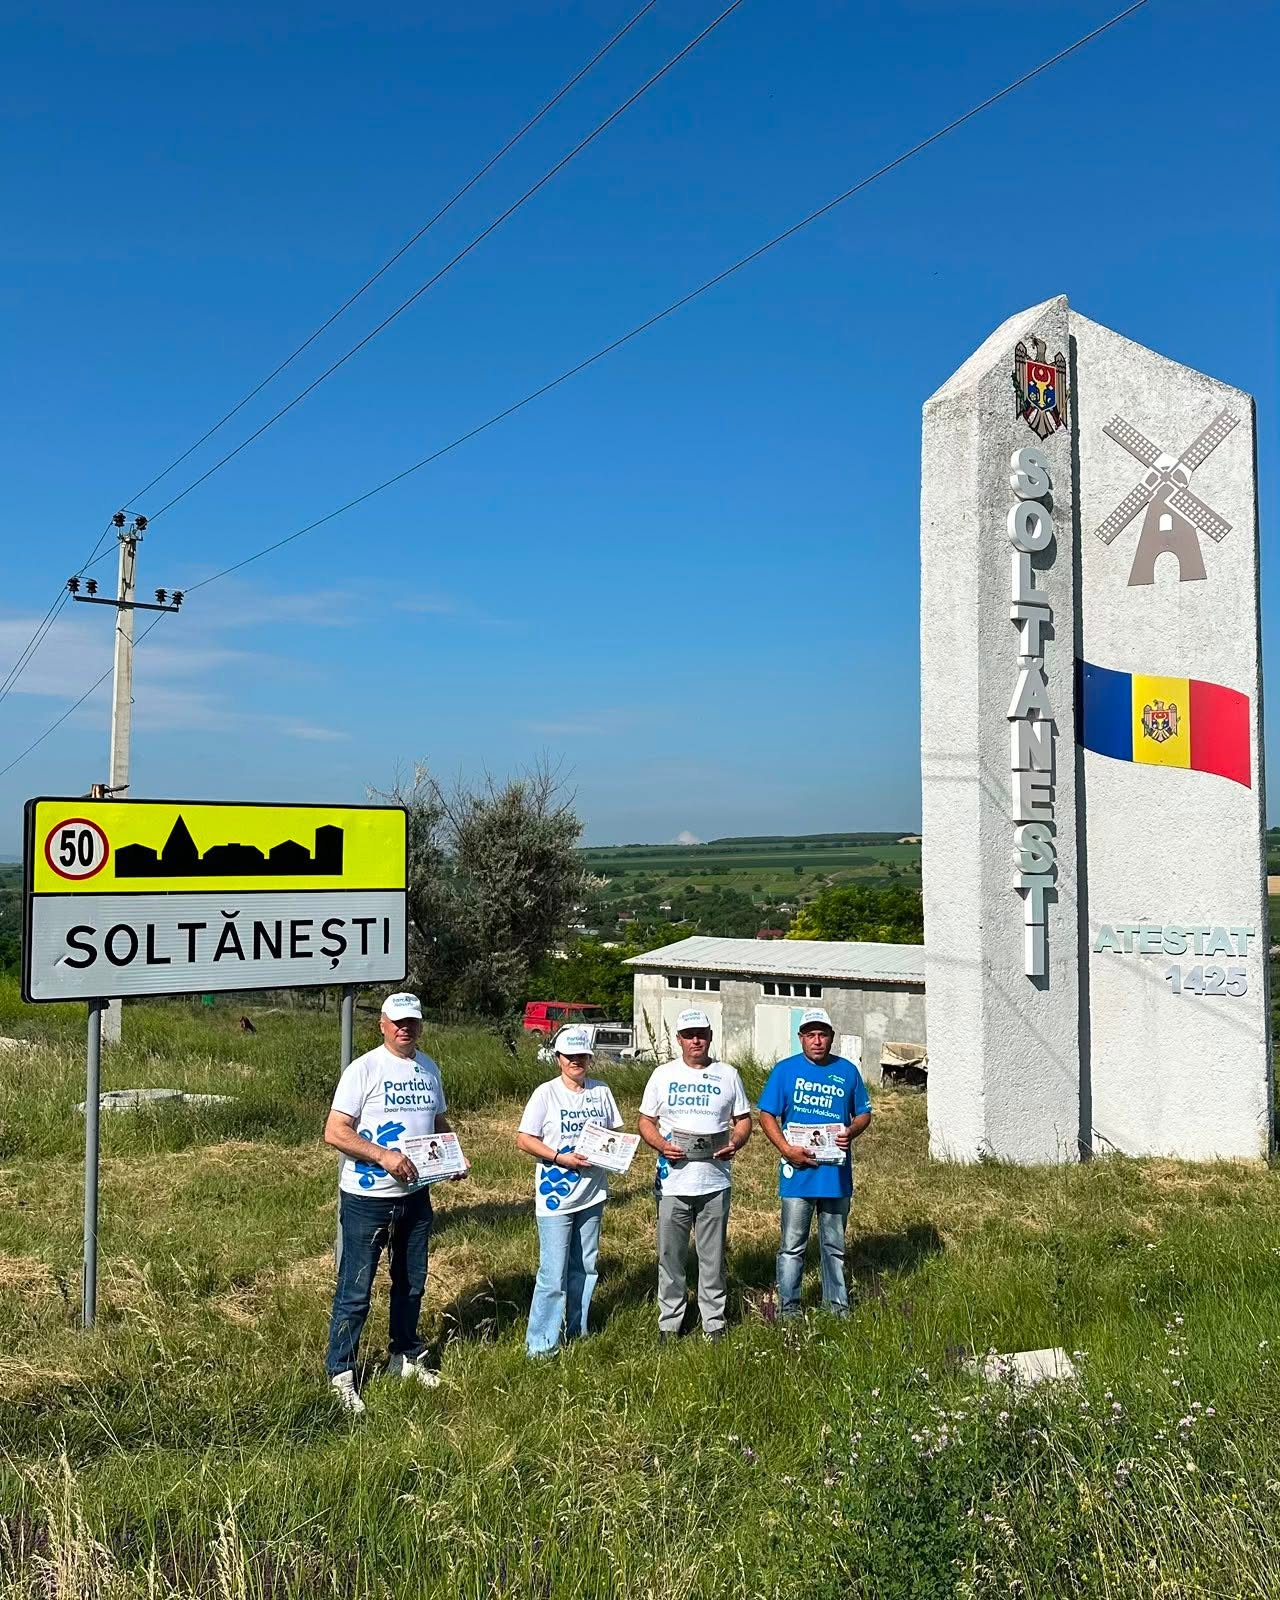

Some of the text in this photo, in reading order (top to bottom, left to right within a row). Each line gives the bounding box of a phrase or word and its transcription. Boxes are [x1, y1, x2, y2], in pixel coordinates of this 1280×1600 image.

[59, 829, 94, 867] 50
[63, 910, 390, 970] SOLTĂNEȘTI
[1093, 924, 1256, 957] ATESTAT
[1165, 964, 1249, 997] 1425
[669, 1082, 721, 1095] Renato
[795, 1077, 845, 1097] Renato
